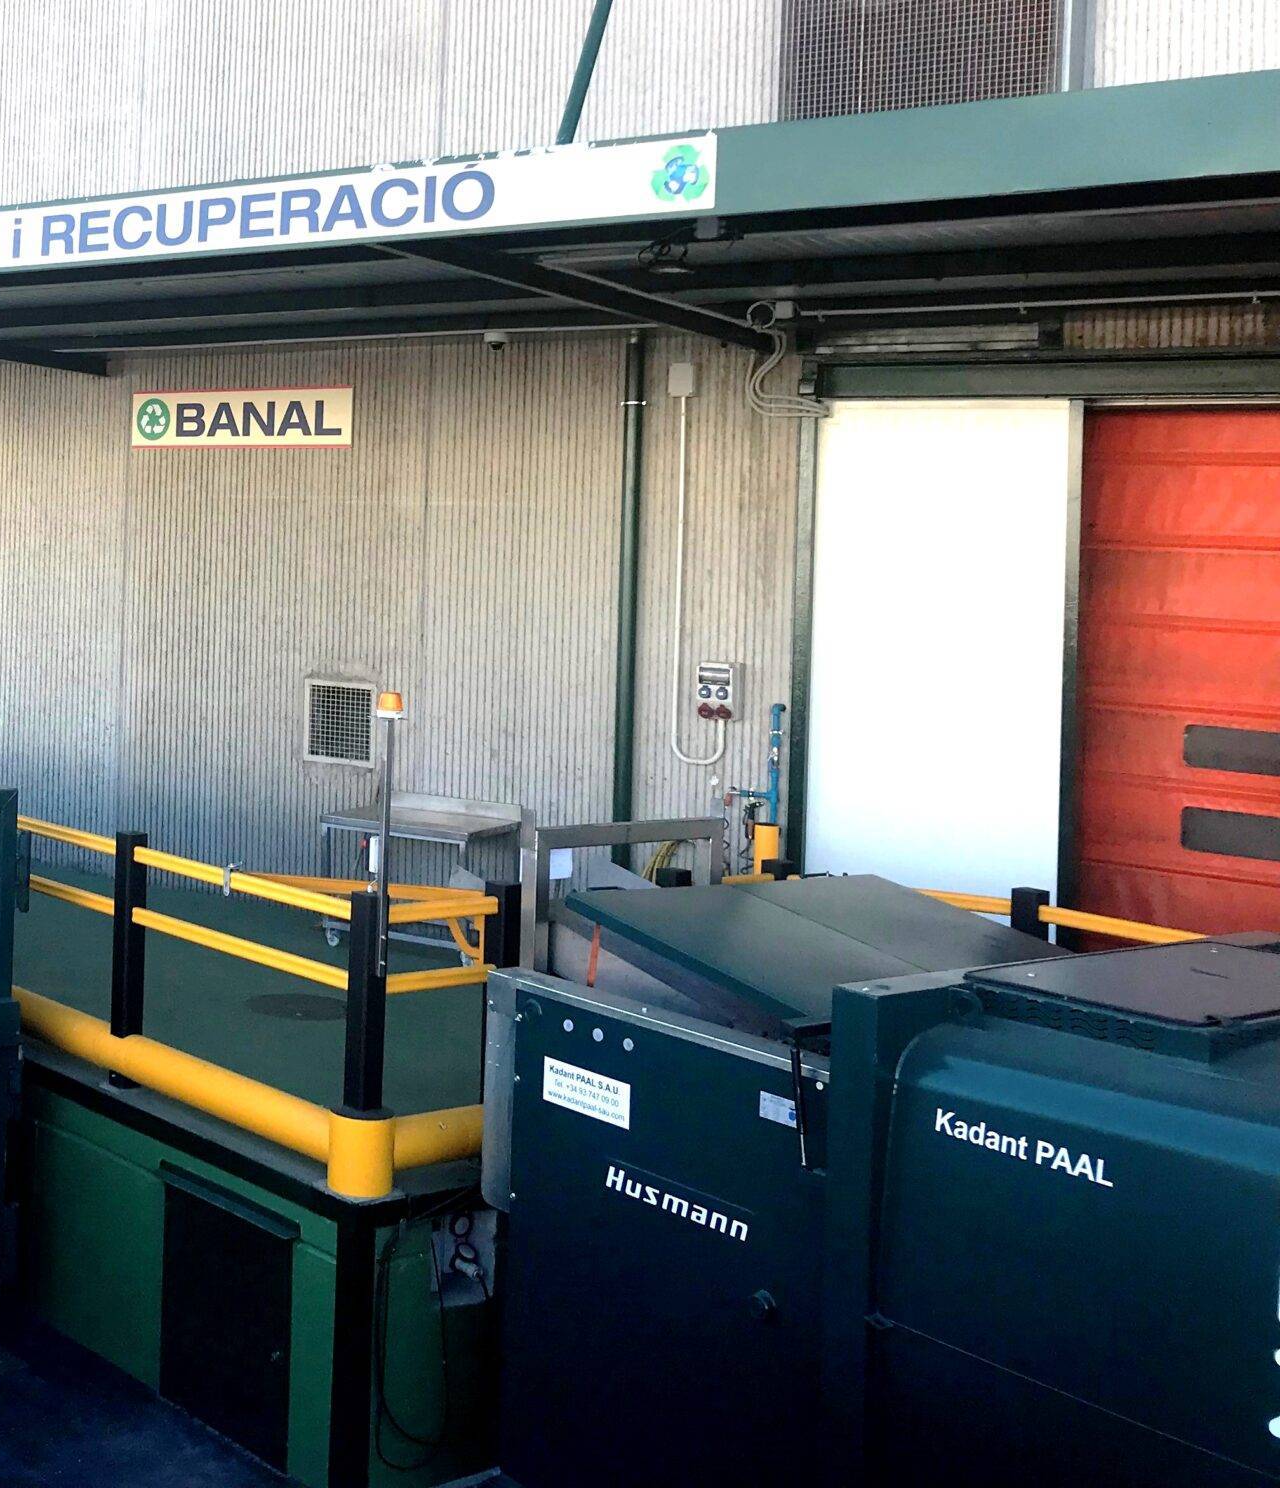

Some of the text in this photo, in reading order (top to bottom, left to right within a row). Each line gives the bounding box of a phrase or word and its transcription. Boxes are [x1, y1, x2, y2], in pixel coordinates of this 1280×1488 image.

[12, 217, 23, 258] i
[40, 163, 496, 257] RECUPERACIÓ
[175, 400, 342, 438] BANAL
[549, 1065, 575, 1080] Kadant
[576, 1073, 596, 1087] PAAL
[935, 1108, 1114, 1187] Kadant PAAL
[605, 1165, 749, 1242] Husmann
